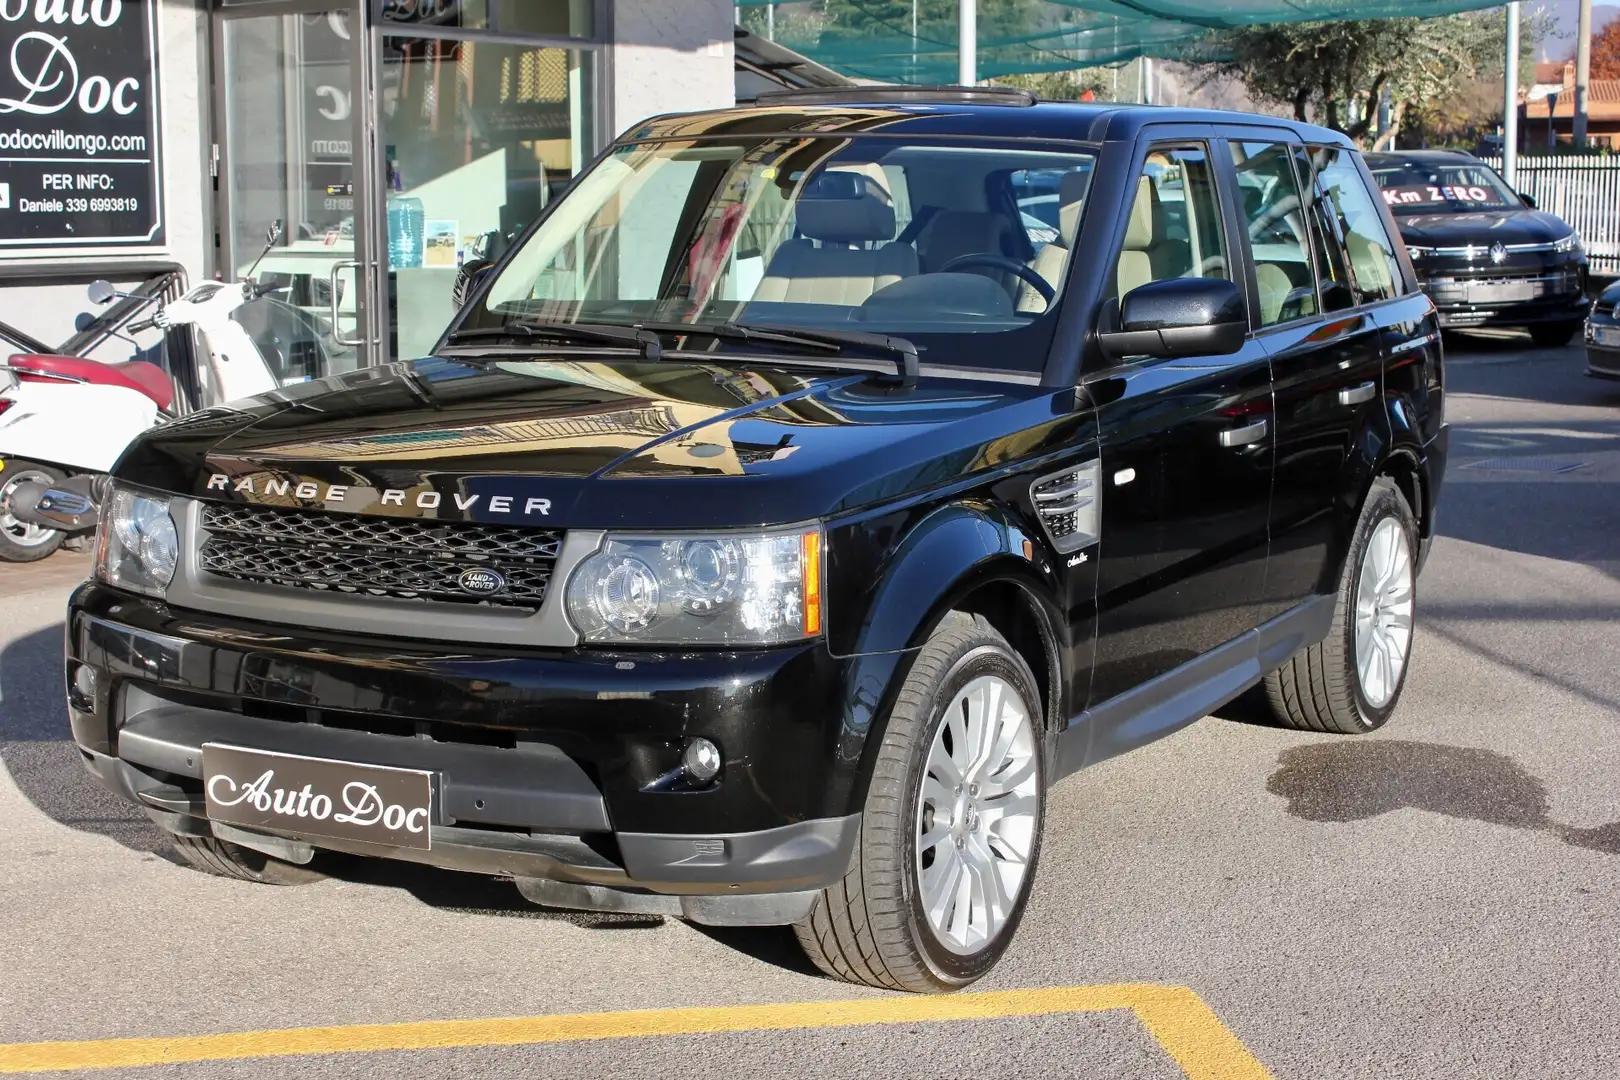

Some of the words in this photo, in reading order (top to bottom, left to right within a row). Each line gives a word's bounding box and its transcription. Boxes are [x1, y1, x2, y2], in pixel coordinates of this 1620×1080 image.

[0, 31, 139, 115] Doc
[0, 129, 146, 155] odocvillongo.com
[43, 174, 73, 190] PER
[76, 174, 114, 190] INFO:
[19, 198, 63, 213] Daniele
[66, 198, 88, 212] 339
[90, 198, 137, 211] 6993819
[1382, 188, 1422, 204] Km
[1426, 186, 1488, 201] ZERO
[206, 472, 349, 502] RANGE
[381, 488, 553, 516] ROVER
[468, 581, 495, 589] ROVER
[207, 769, 332, 819] Auto
[333, 781, 428, 833] Doc
